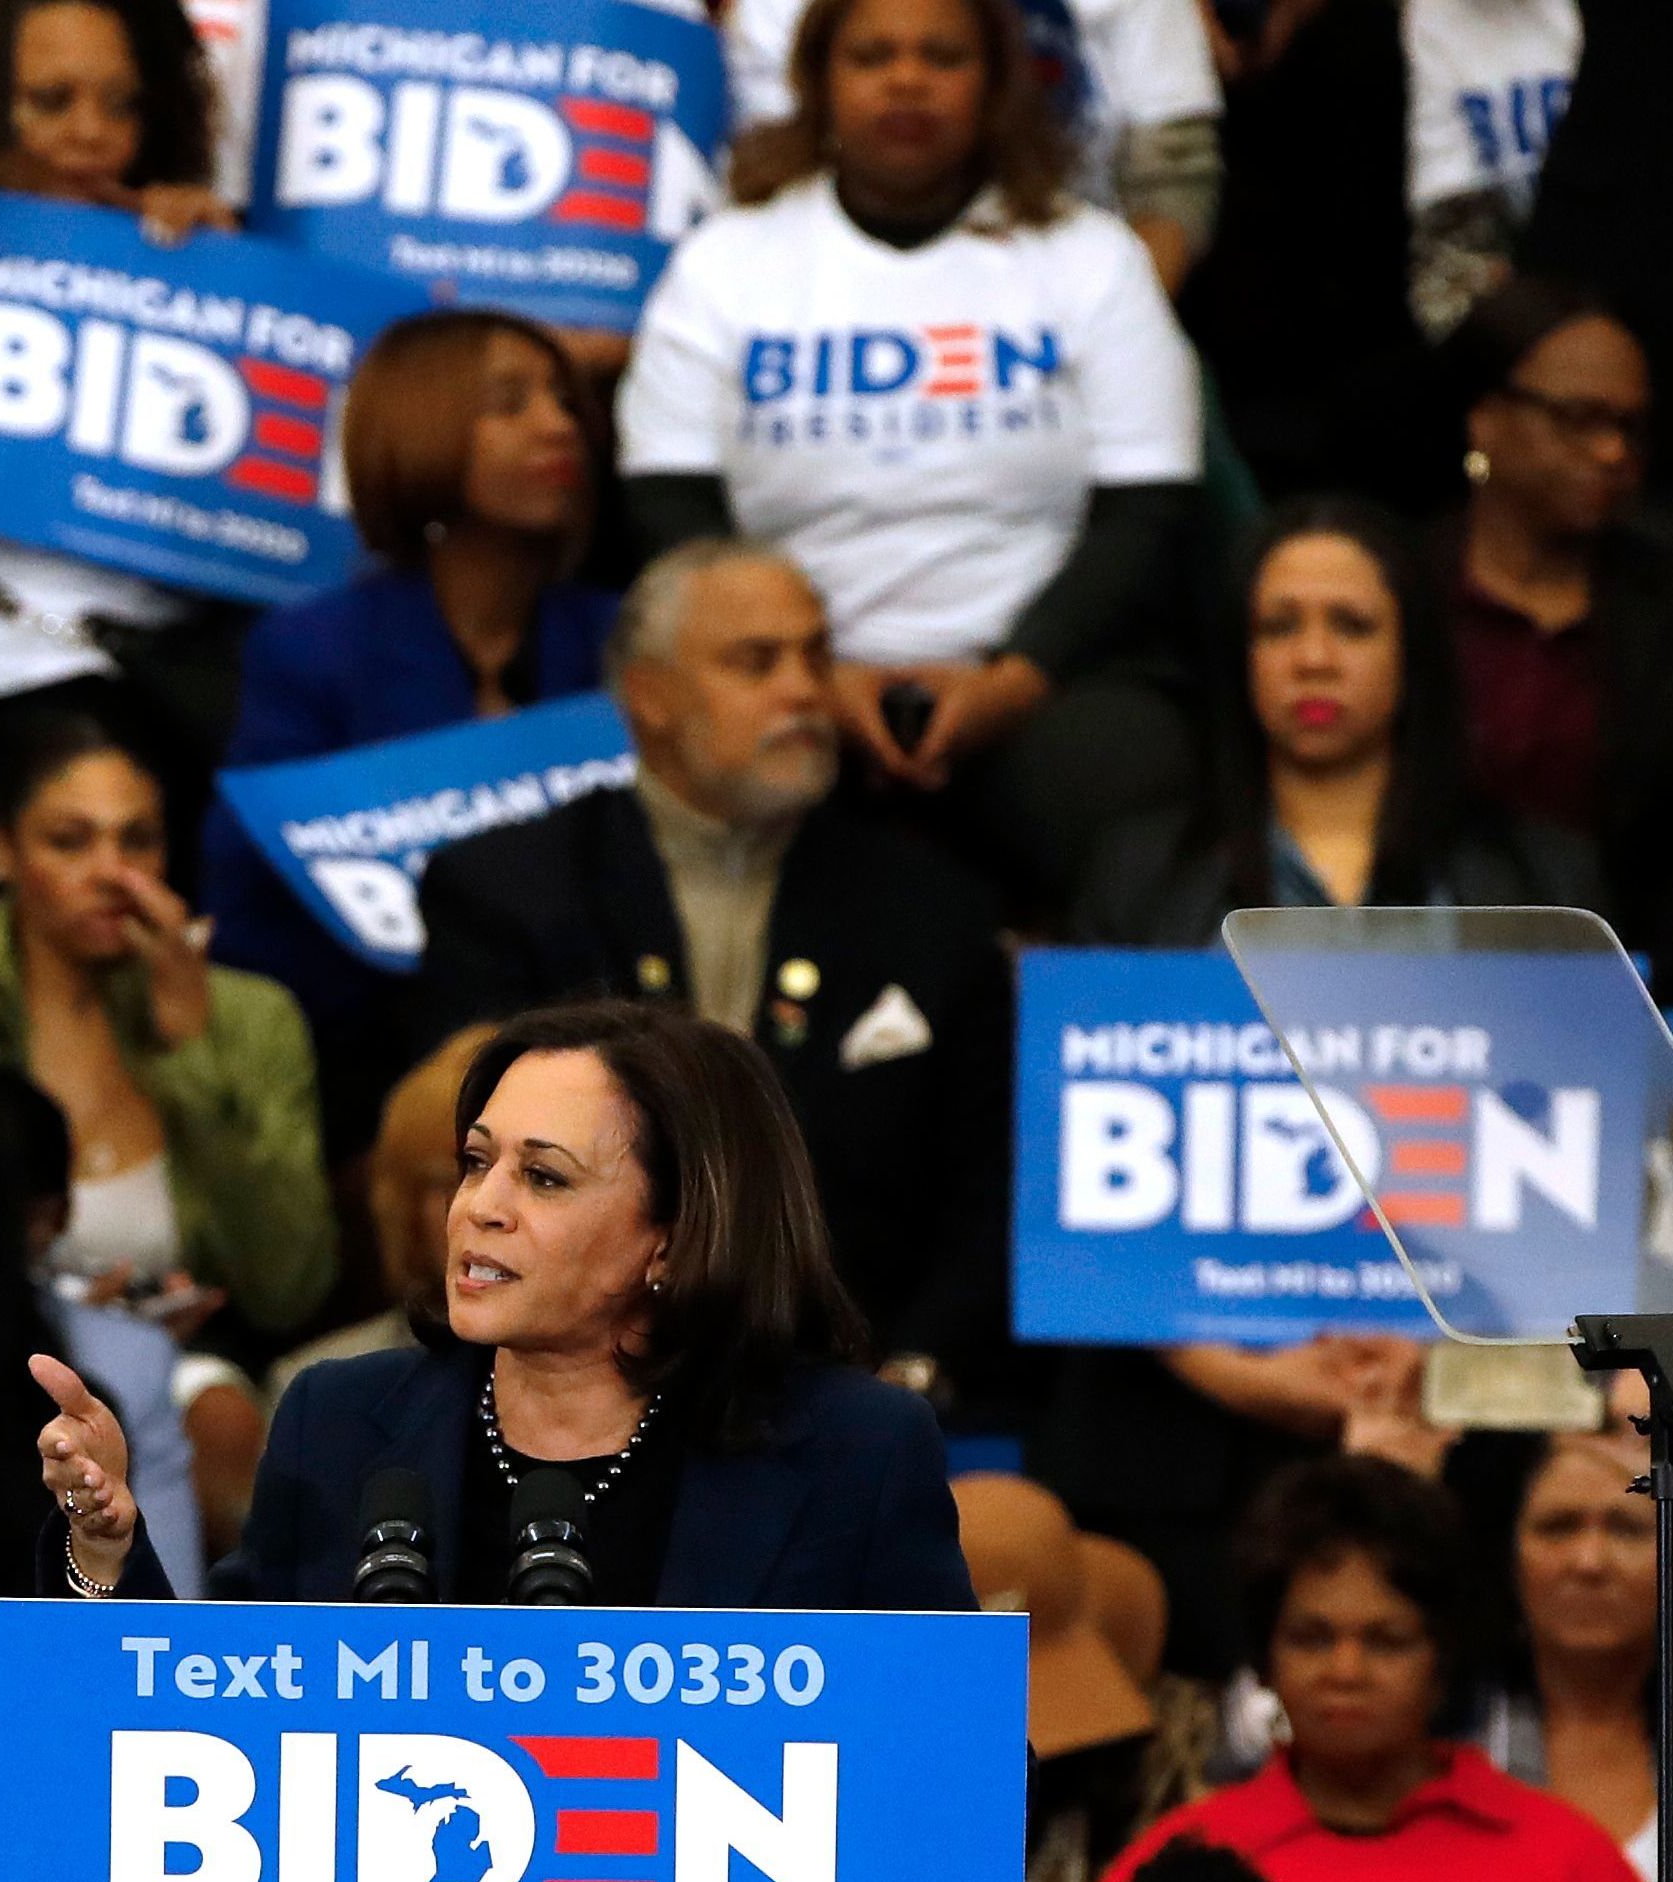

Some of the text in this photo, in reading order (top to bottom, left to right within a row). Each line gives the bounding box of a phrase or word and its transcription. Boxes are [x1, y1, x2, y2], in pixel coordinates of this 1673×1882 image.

[284, 22, 677, 104] MICHIGAN FOR
[245, 304, 356, 372] FOR
[743, 321, 1063, 409] BIDEN
[1060, 1022, 1492, 1076] MICHIGAN FOR
[1058, 1080, 1601, 1234] BIDEN
[121, 1636, 826, 1706] Text MI to 30330
